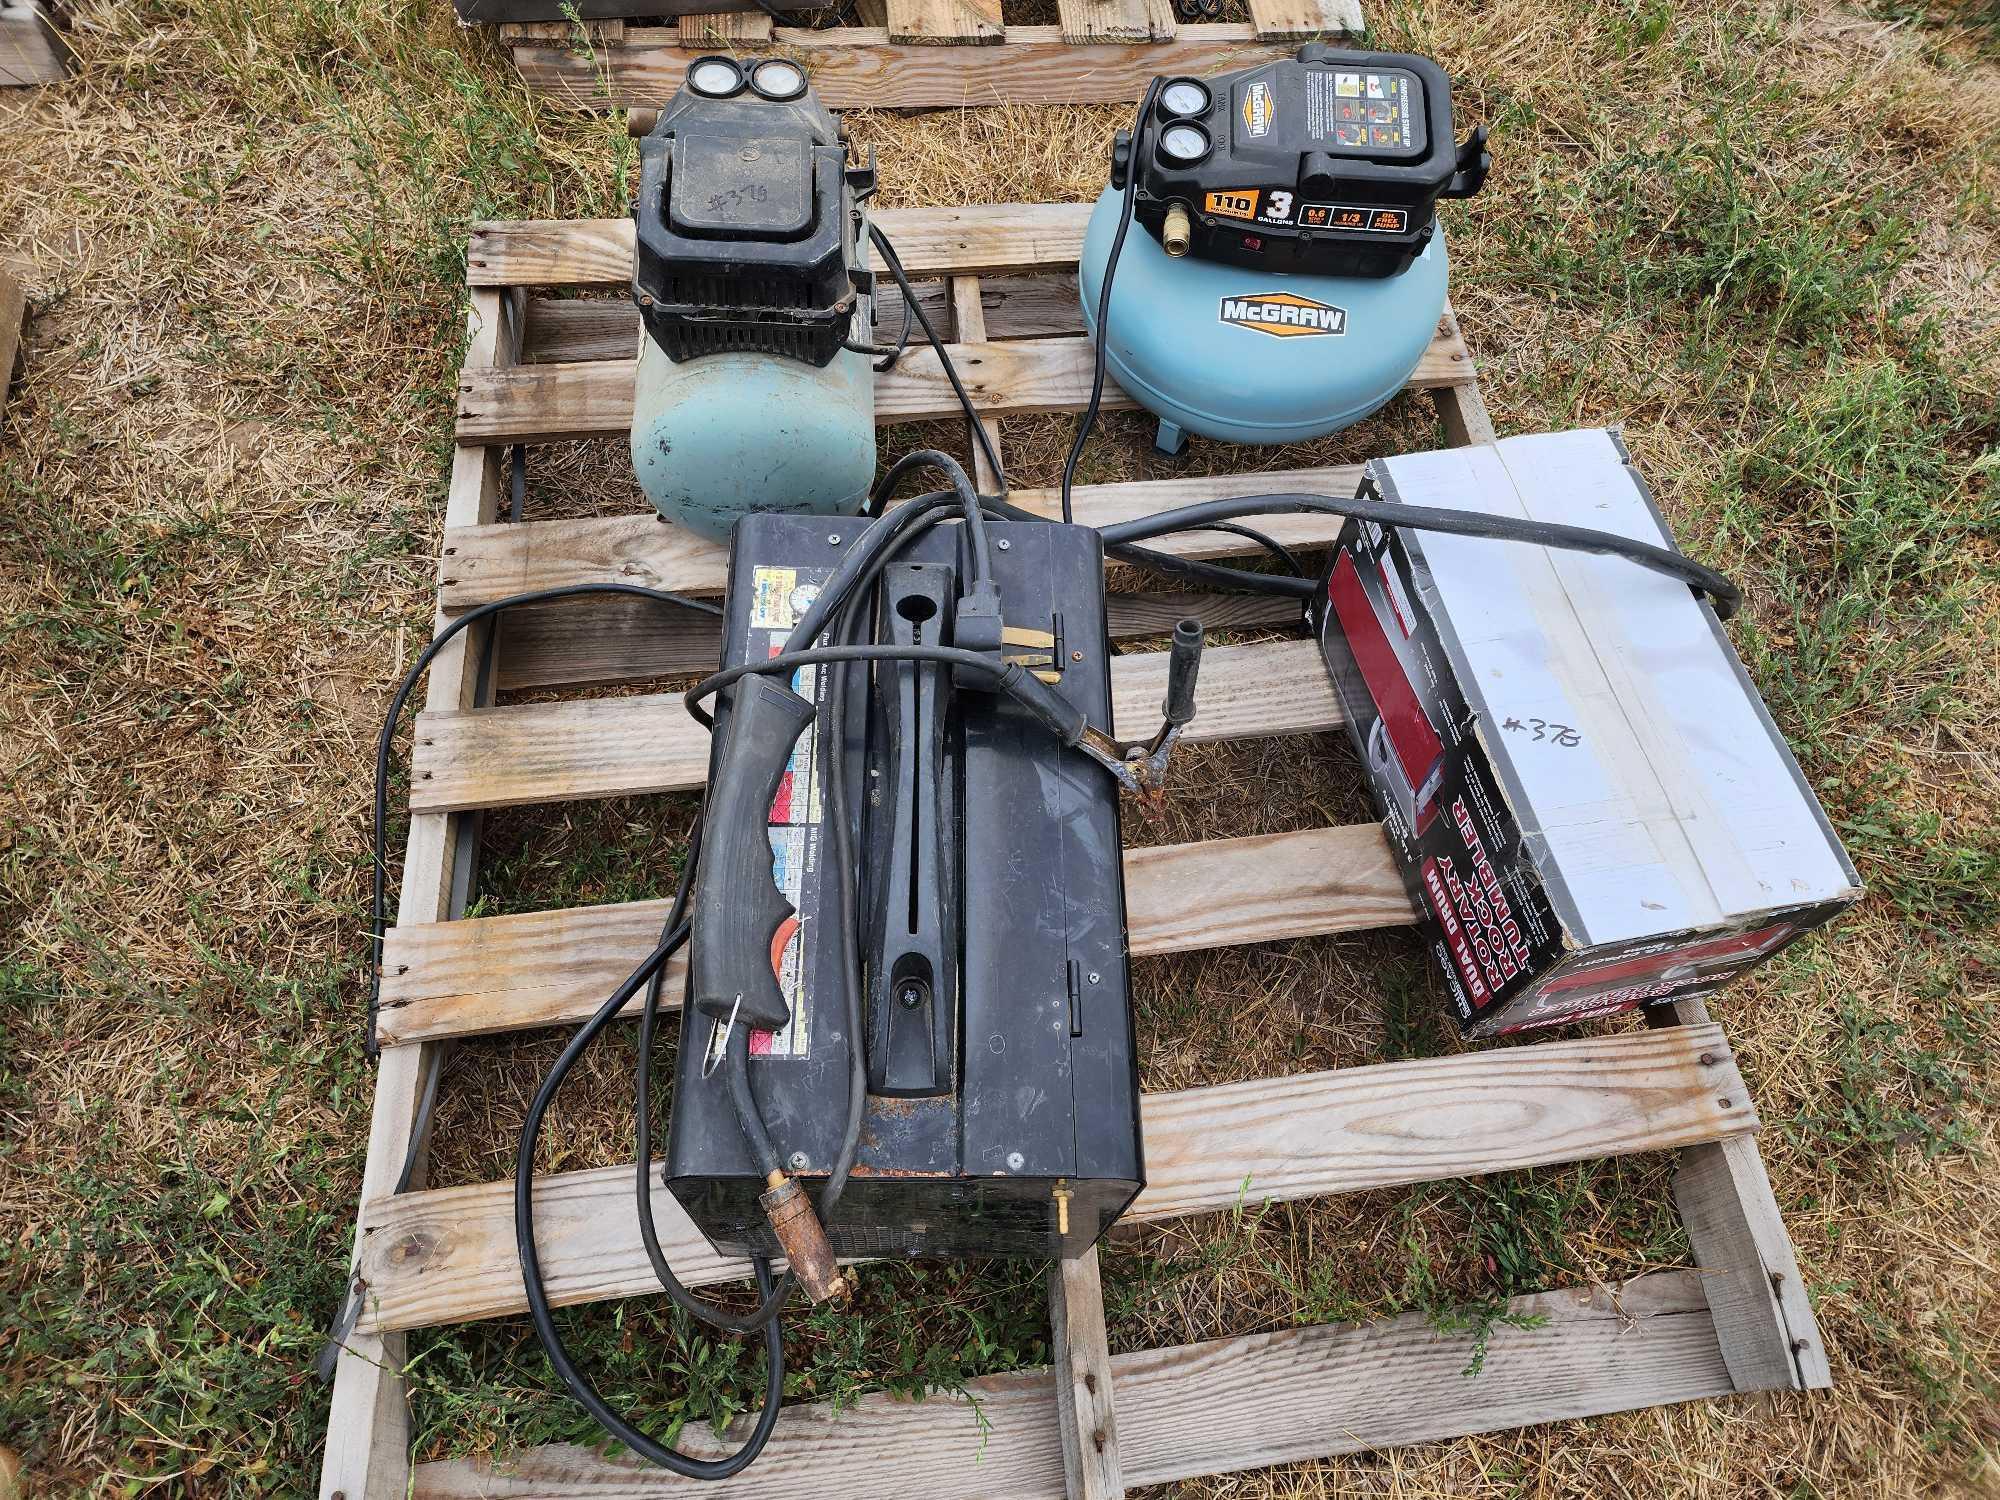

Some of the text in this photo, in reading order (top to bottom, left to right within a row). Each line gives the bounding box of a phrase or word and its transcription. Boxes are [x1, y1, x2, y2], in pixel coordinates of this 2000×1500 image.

[1402, 119, 1410, 138] START
[1212, 194, 1251, 211] 110
[1265, 190, 1294, 219] 3
[1307, 208, 1326, 218] 0.6
[1257, 216, 1294, 225] GALLONS
[1341, 213, 1361, 223] 1/3
[819, 675, 829, 702] Welding
[806, 842, 817, 873] Welding
[1452, 794, 1531, 971] TUMBLER
[1427, 869, 1459, 935] DRUM
[1436, 855, 1505, 992] ROTARY
[1465, 870, 1518, 982] ROCK
[1456, 937, 1485, 998] DUAL
